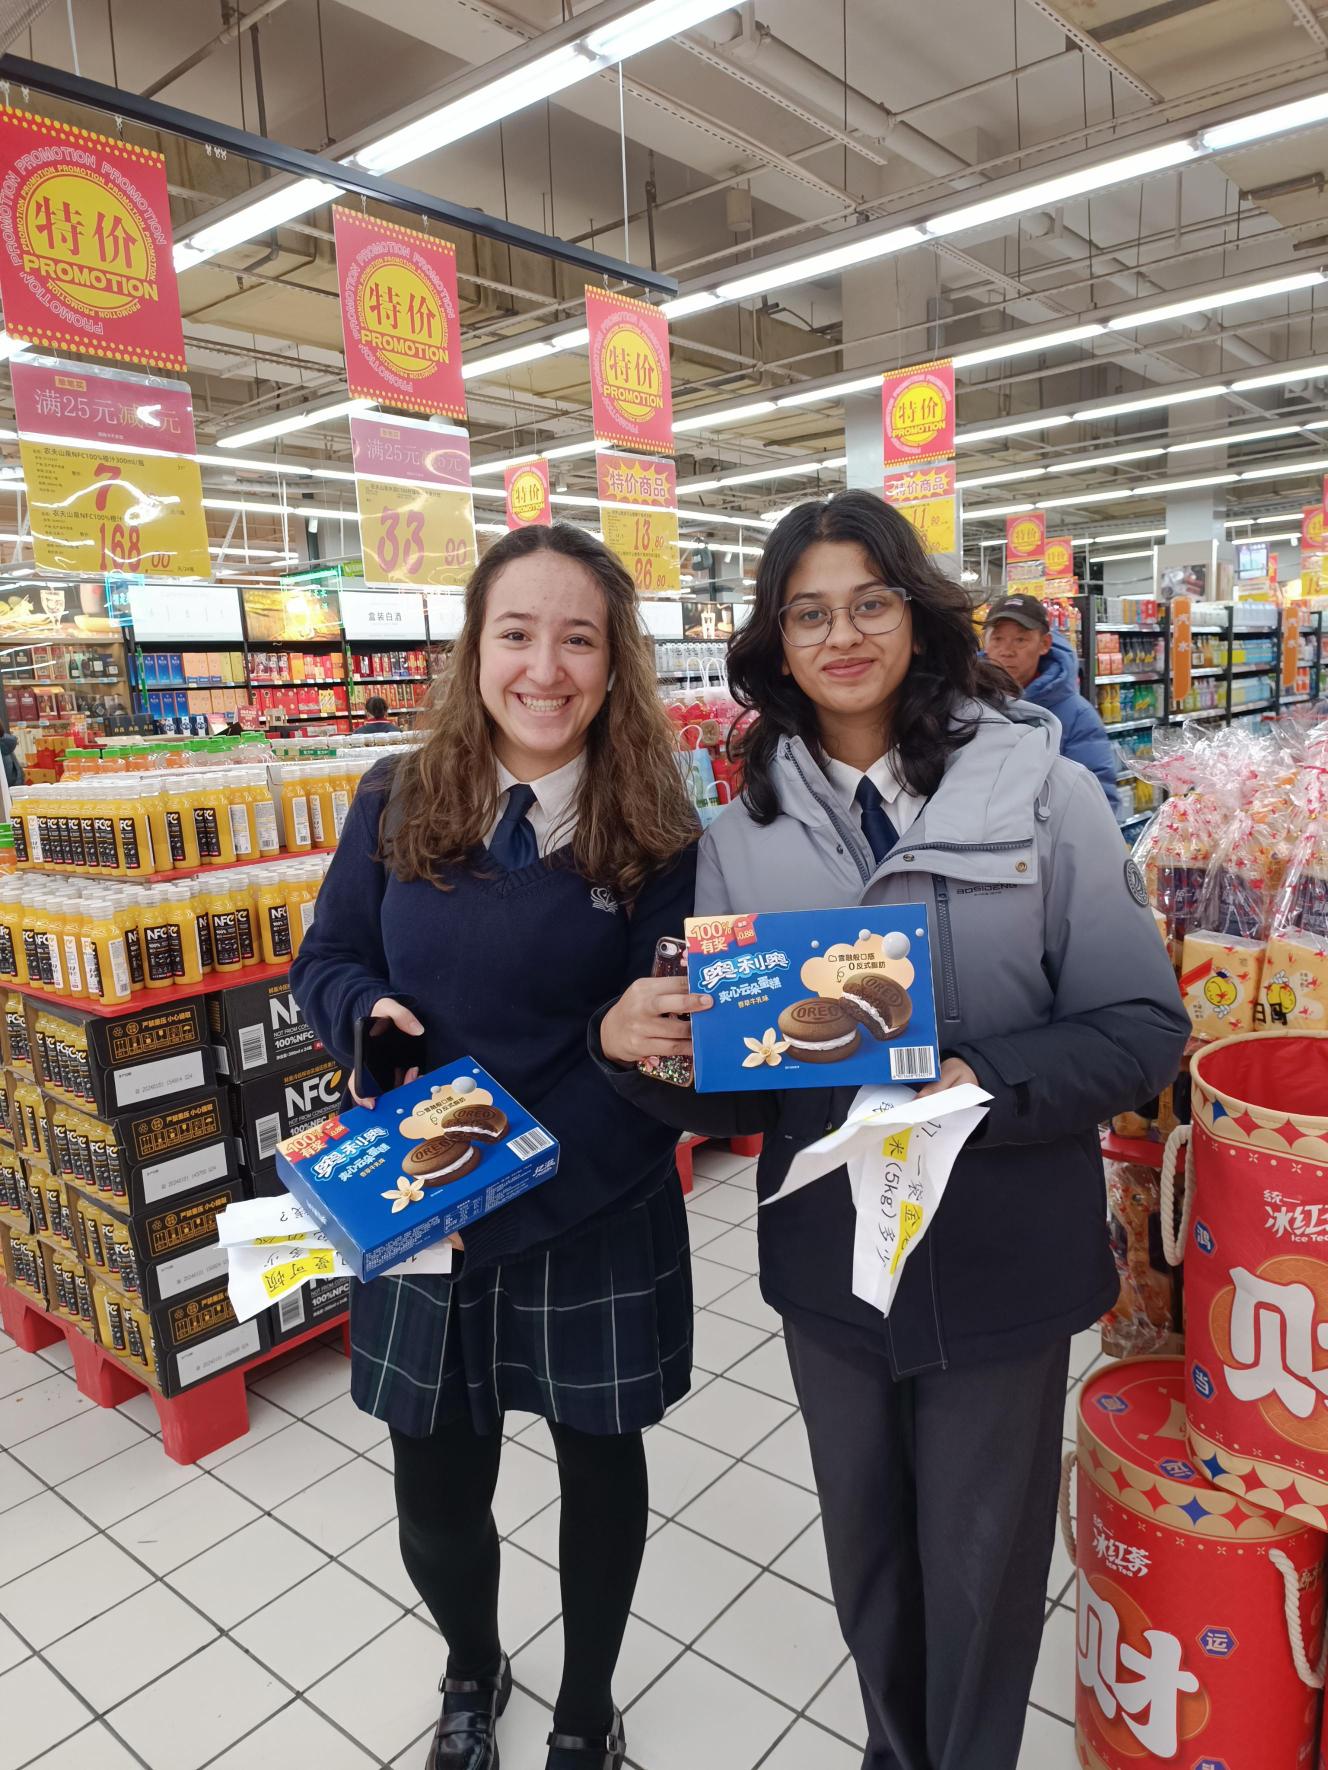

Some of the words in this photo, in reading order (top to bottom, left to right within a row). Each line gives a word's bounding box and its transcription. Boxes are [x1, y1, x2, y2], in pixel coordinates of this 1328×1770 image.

[14, 146, 96, 174] PROMOTION
[57, 165, 105, 183] PROMOTION
[101, 161, 167, 245] PROMOTION
[108, 184, 146, 229] PROMOTION
[0, 171, 22, 266] PROMOTION
[35, 195, 138, 269] 特价
[356, 241, 410, 266] PROMOTION
[22, 254, 159, 302] PROMOTION
[19, 272, 104, 334] PROMOTION
[368, 282, 436, 339] 特价
[361, 330, 449, 364] PROMOTION
[609, 345, 654, 389] 特价
[603, 384, 664, 408] PROMOTION
[34, 389, 181, 434] 满25元减元
[898, 397, 938, 424] 特价
[892, 420, 946, 438] PROMOTION
[93, 463, 122, 512] 7
[609, 470, 666, 497] 特价商品
[368, 611, 402, 621] 盒装白酒
[119, 819, 132, 830] FC
[214, 914, 234, 926] NFC
[692, 920, 732, 940] 100%
[147, 928, 168, 940] NFC
[700, 937, 728, 955] 有奖
[702, 952, 790, 988] 奥利奥
[718, 976, 782, 1004] 夹心云朵蛋糕
[738, 995, 769, 1008] 香草牛乳味
[864, 976, 900, 1007] OREO
[797, 1003, 839, 1019] OREO
[273, 1030, 284, 1038] NOT
[284, 1027, 298, 1035] FROM
[275, 1030, 315, 1049] 100%NFC
[285, 1070, 342, 1118] NFC
[288, 1117, 298, 1126] NOT
[298, 1112, 311, 1121] FROM
[457, 1107, 495, 1121] OREO
[90, 1142, 105, 1153] FC
[286, 1130, 324, 1152] 100%
[300, 1140, 328, 1158] 有奖
[313, 1127, 387, 1178] 奥利奥
[412, 1140, 454, 1162] OREO
[338, 1143, 391, 1182] 夹心云朵蛋糕
[1263, 1189, 1301, 1205] 统一
[1291, 1235, 1308, 1243] Ice
[312, 1283, 349, 1306] 100%NFC
[1092, 1528, 1152, 1577] 冰红茶
[1106, 1560, 1117, 1570] Ice
[1118, 1566, 1133, 1577] Tea
[1207, 1633, 1229, 1653] 运
